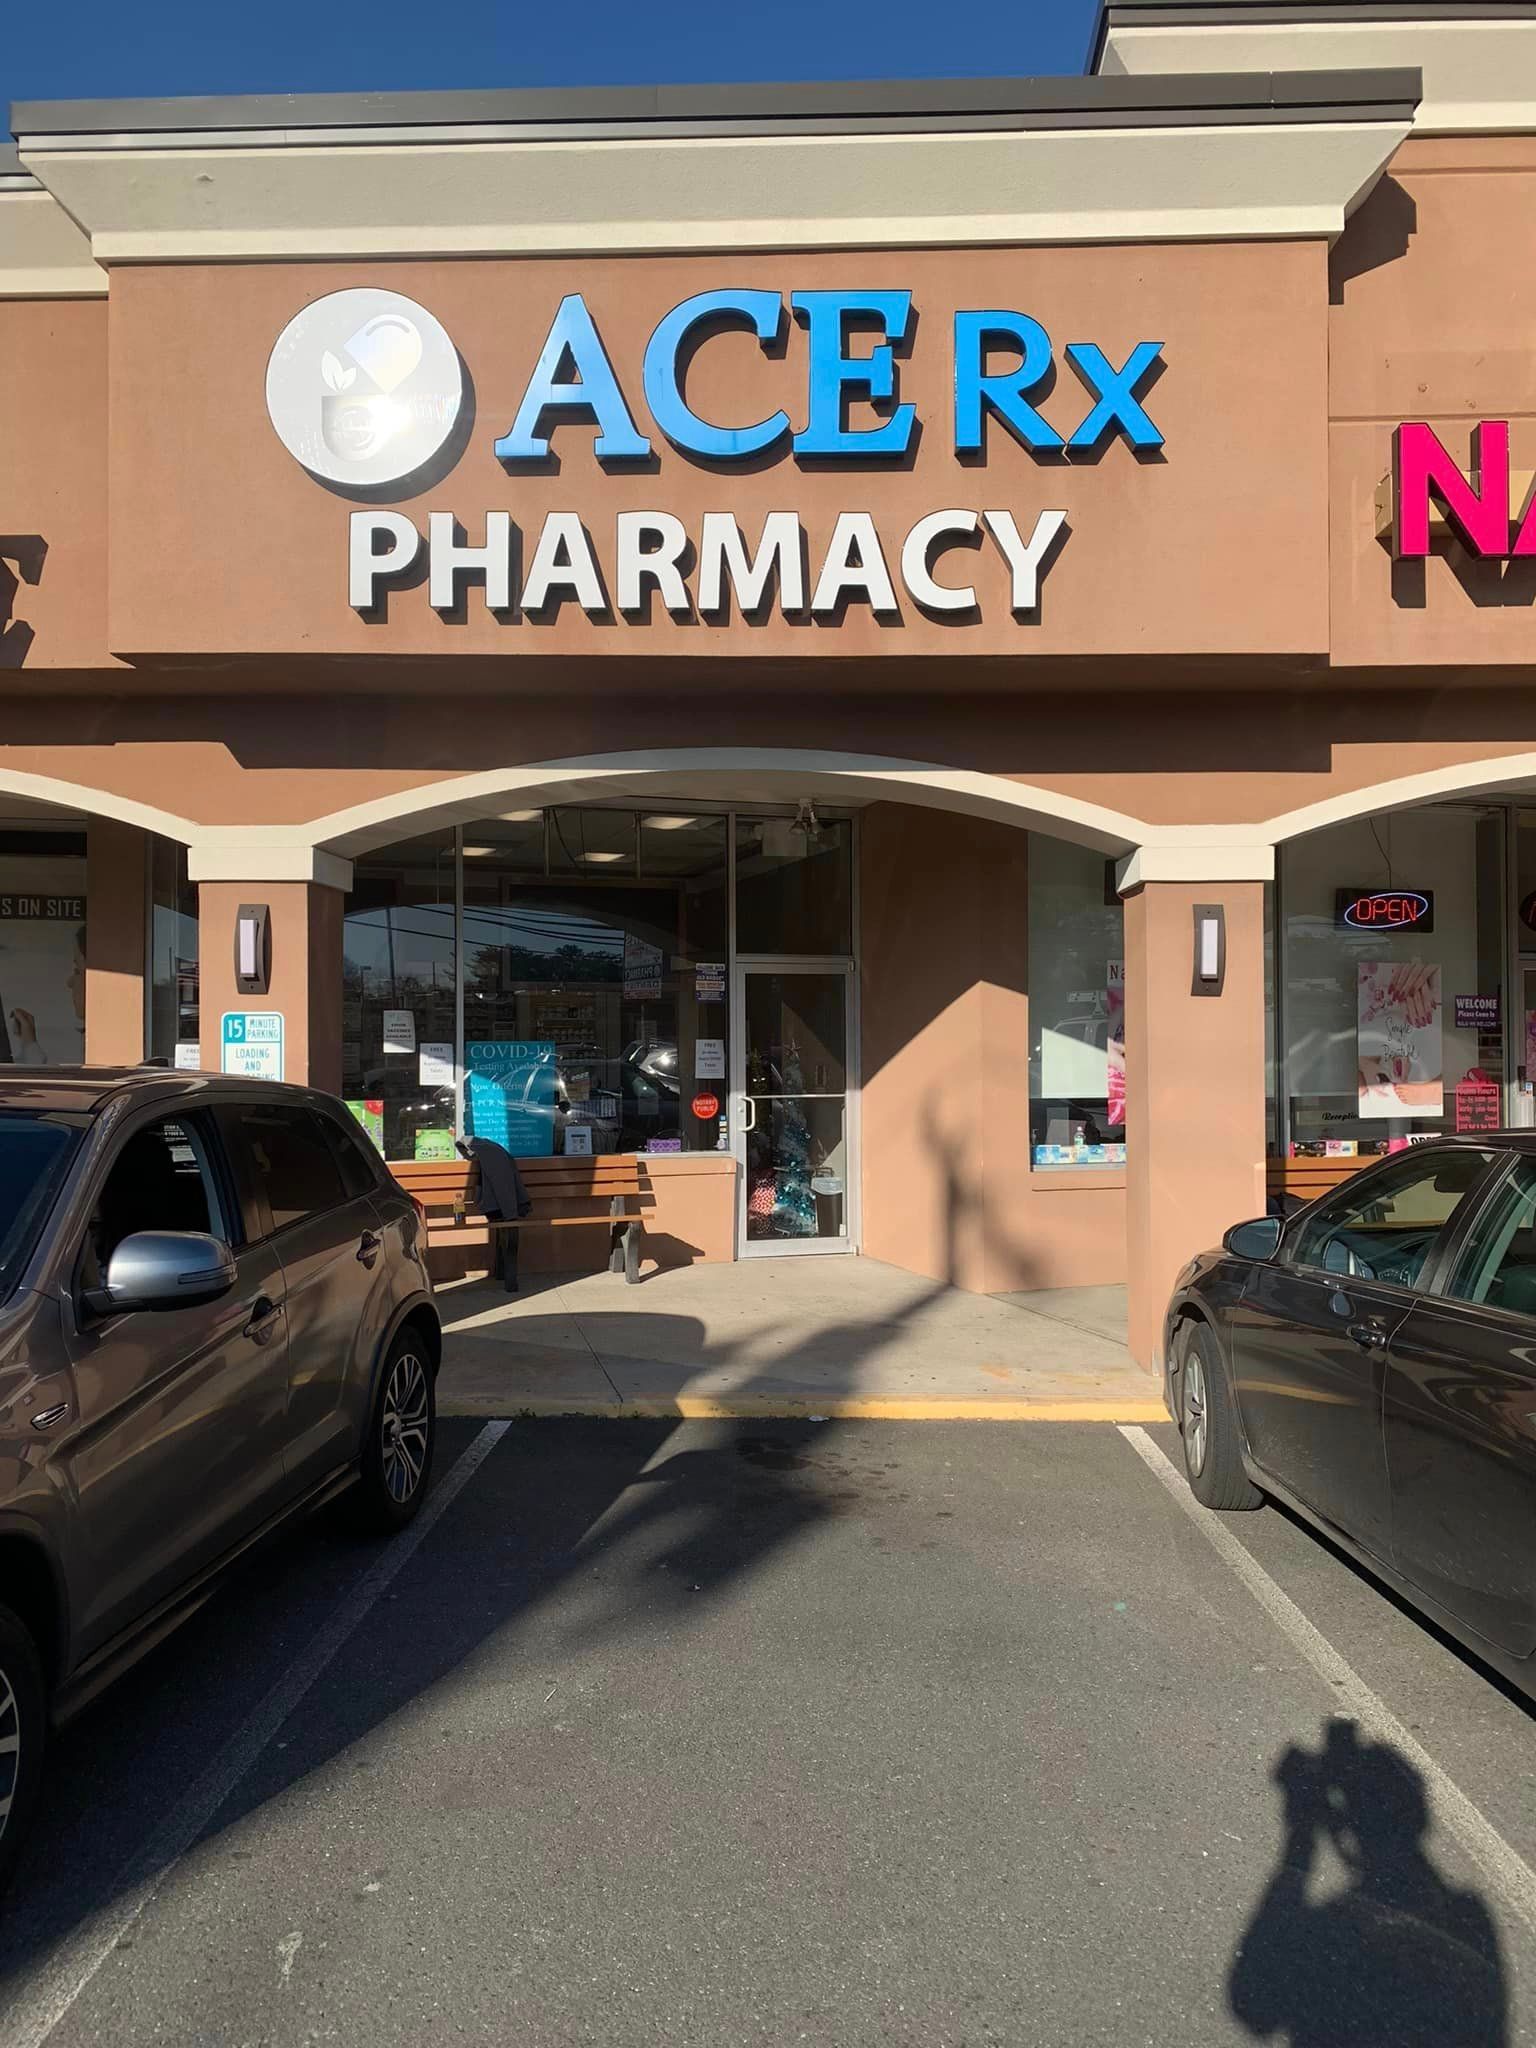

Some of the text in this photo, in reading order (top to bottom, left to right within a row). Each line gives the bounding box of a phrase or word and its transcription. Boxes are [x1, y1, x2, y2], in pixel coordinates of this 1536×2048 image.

[494, 288, 1166, 461] ACE Rx
[348, 508, 1068, 611] PHARMACY
[18, 898, 40, 916] ON
[47, 899, 81, 917] SITE
[1356, 898, 1417, 921] OPEN
[1456, 998, 1498, 1009] WELCOME
[1457, 1010, 1475, 1018] Please
[227, 1019, 243, 1039] 15
[249, 1018, 276, 1028] MINUTE
[247, 1029, 279, 1039] PARKING
[235, 1047, 270, 1059] LOADING
[470, 1044, 553, 1060] COVID-19
[244, 1060, 262, 1071] AND
[473, 1062, 505, 1073] Testing
